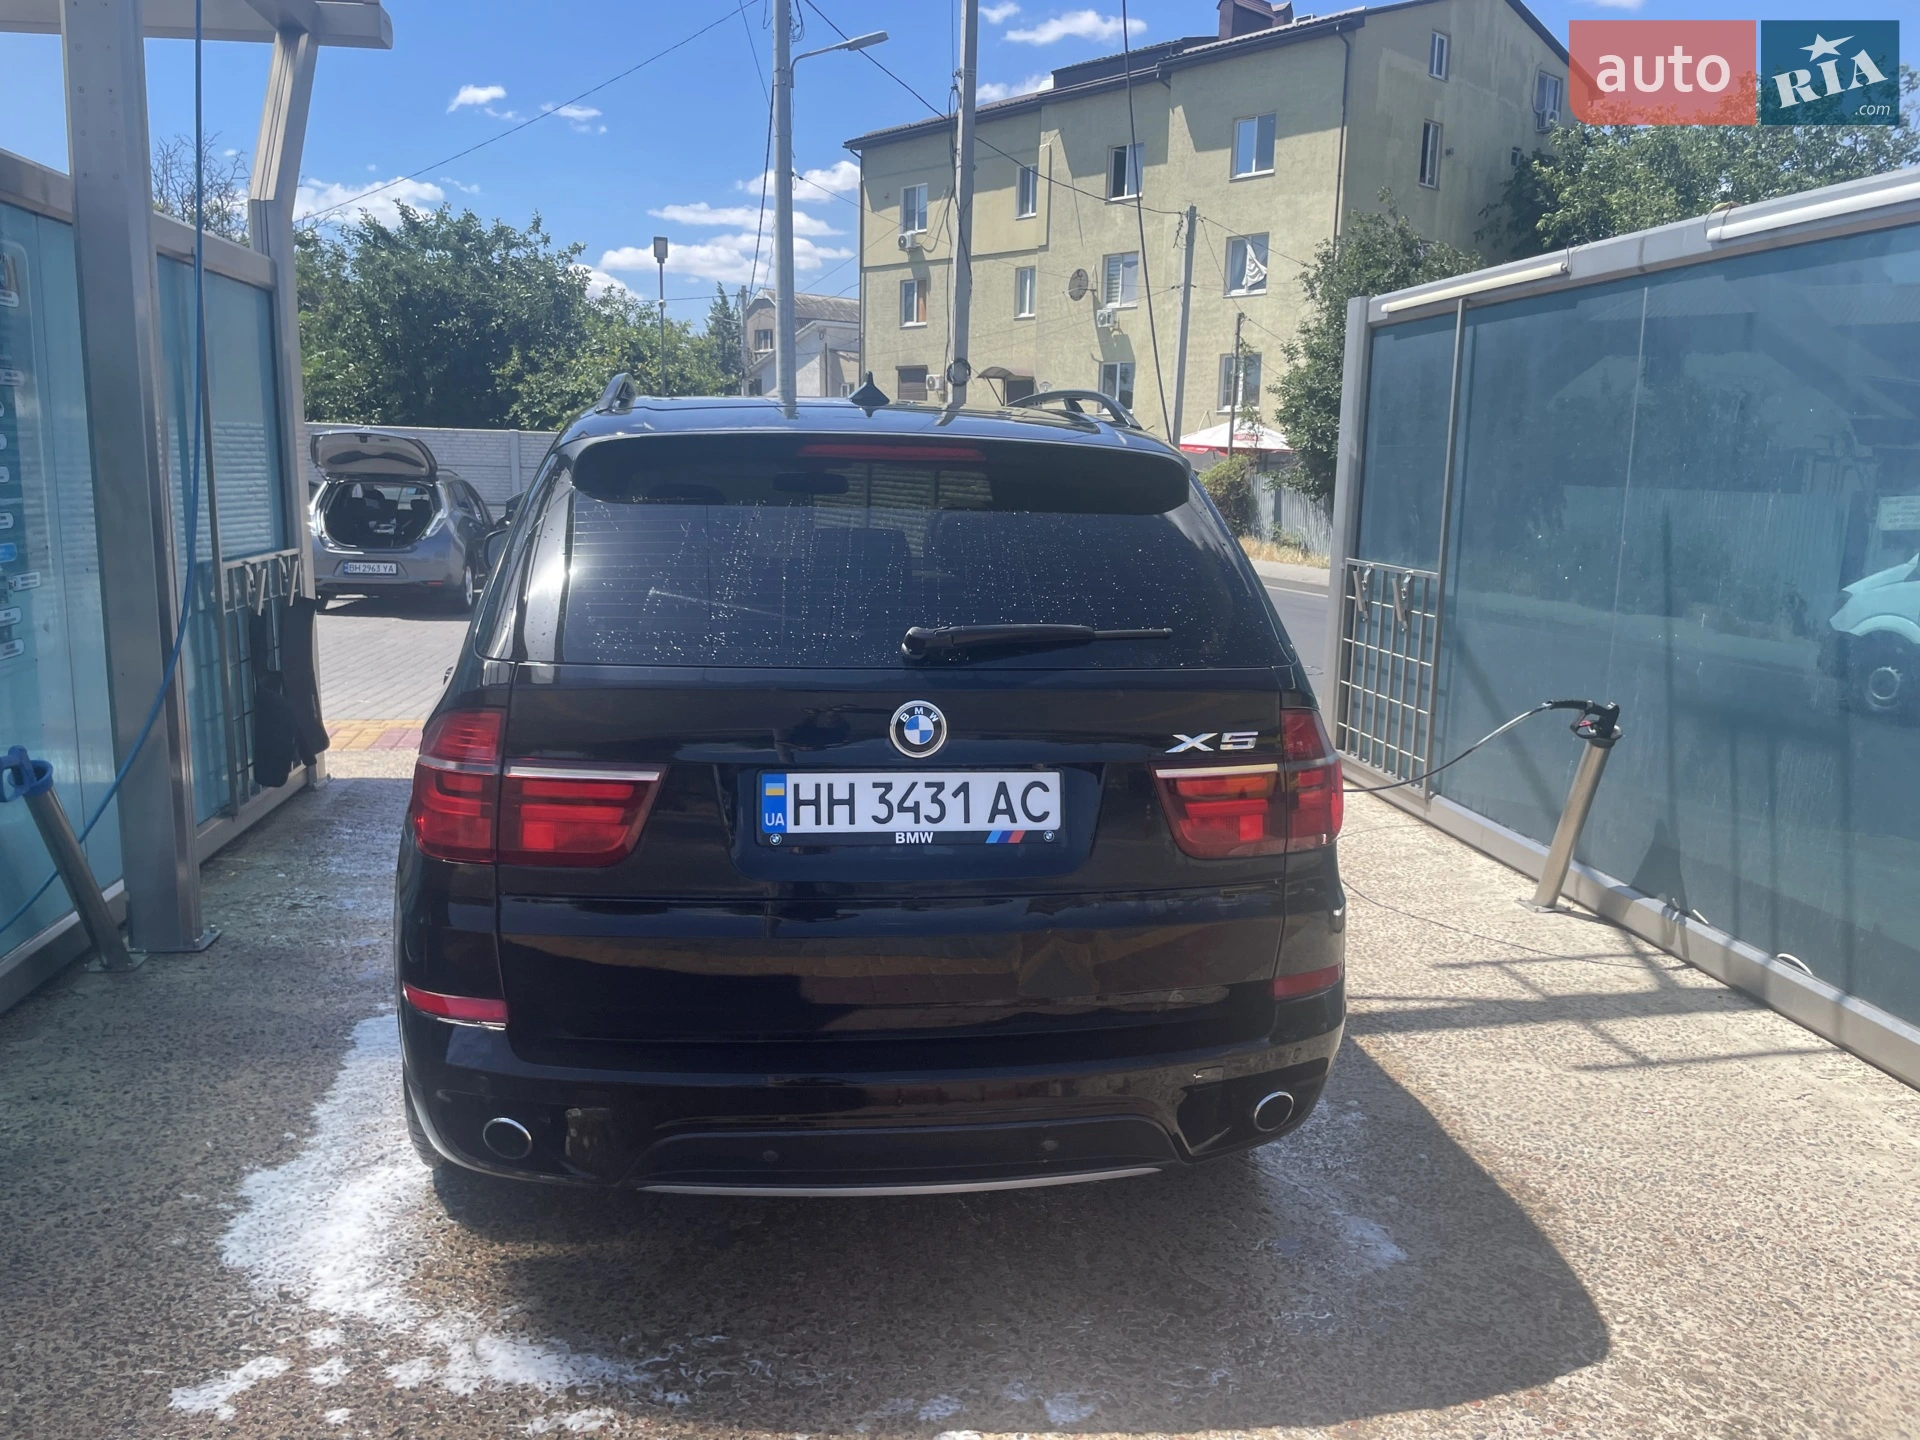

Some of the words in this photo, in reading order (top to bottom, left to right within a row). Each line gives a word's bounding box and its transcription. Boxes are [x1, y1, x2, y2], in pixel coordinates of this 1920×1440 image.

[349, 564, 361, 572] BH
[362, 564, 381, 572] 2963
[382, 564, 394, 573] YA
[899, 706, 939, 723] BMW
[1164, 731, 1259, 753] X5
[793, 782, 856, 826] HH
[871, 781, 971, 825] 3431
[987, 780, 1051, 824] AC
[765, 813, 785, 826] UA
[895, 832, 934, 844] BMW
